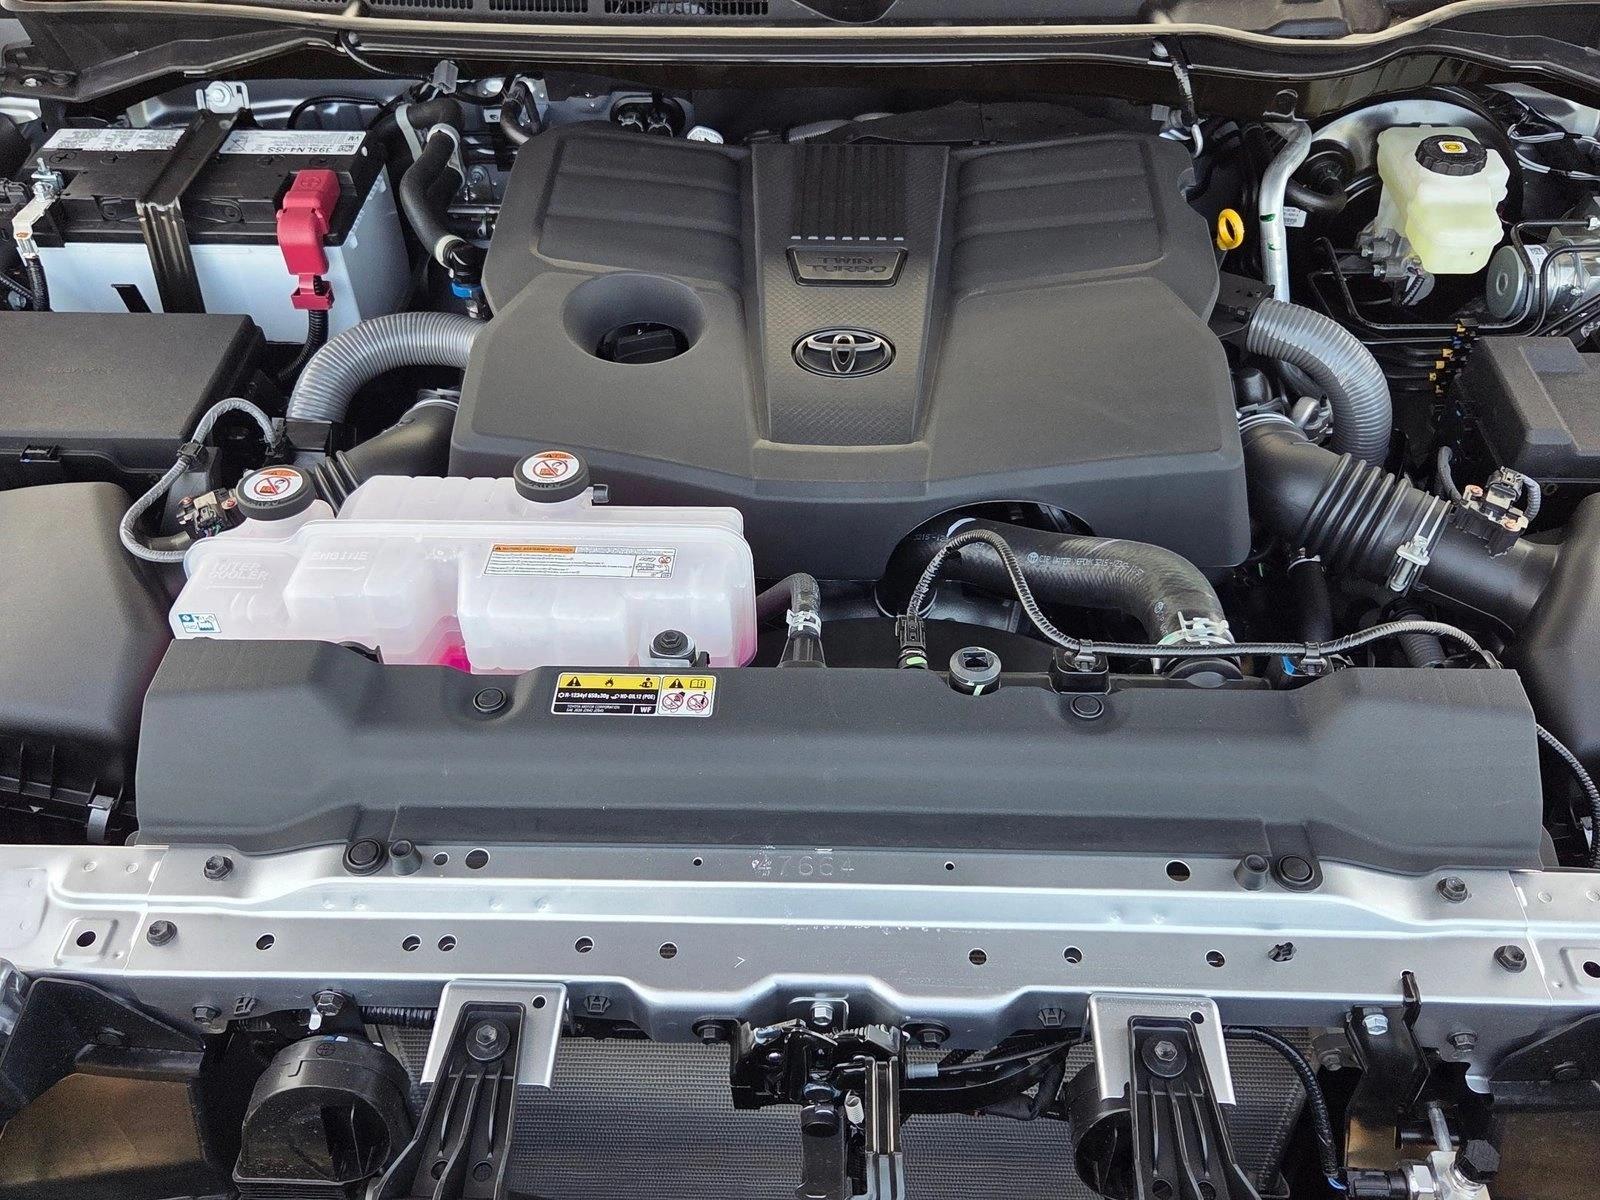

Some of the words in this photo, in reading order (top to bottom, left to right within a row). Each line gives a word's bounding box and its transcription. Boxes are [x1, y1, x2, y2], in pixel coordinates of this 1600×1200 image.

[819, 256, 874, 265] TWIN
[806, 265, 888, 273] TURBO
[311, 551, 370, 560] ENGINE
